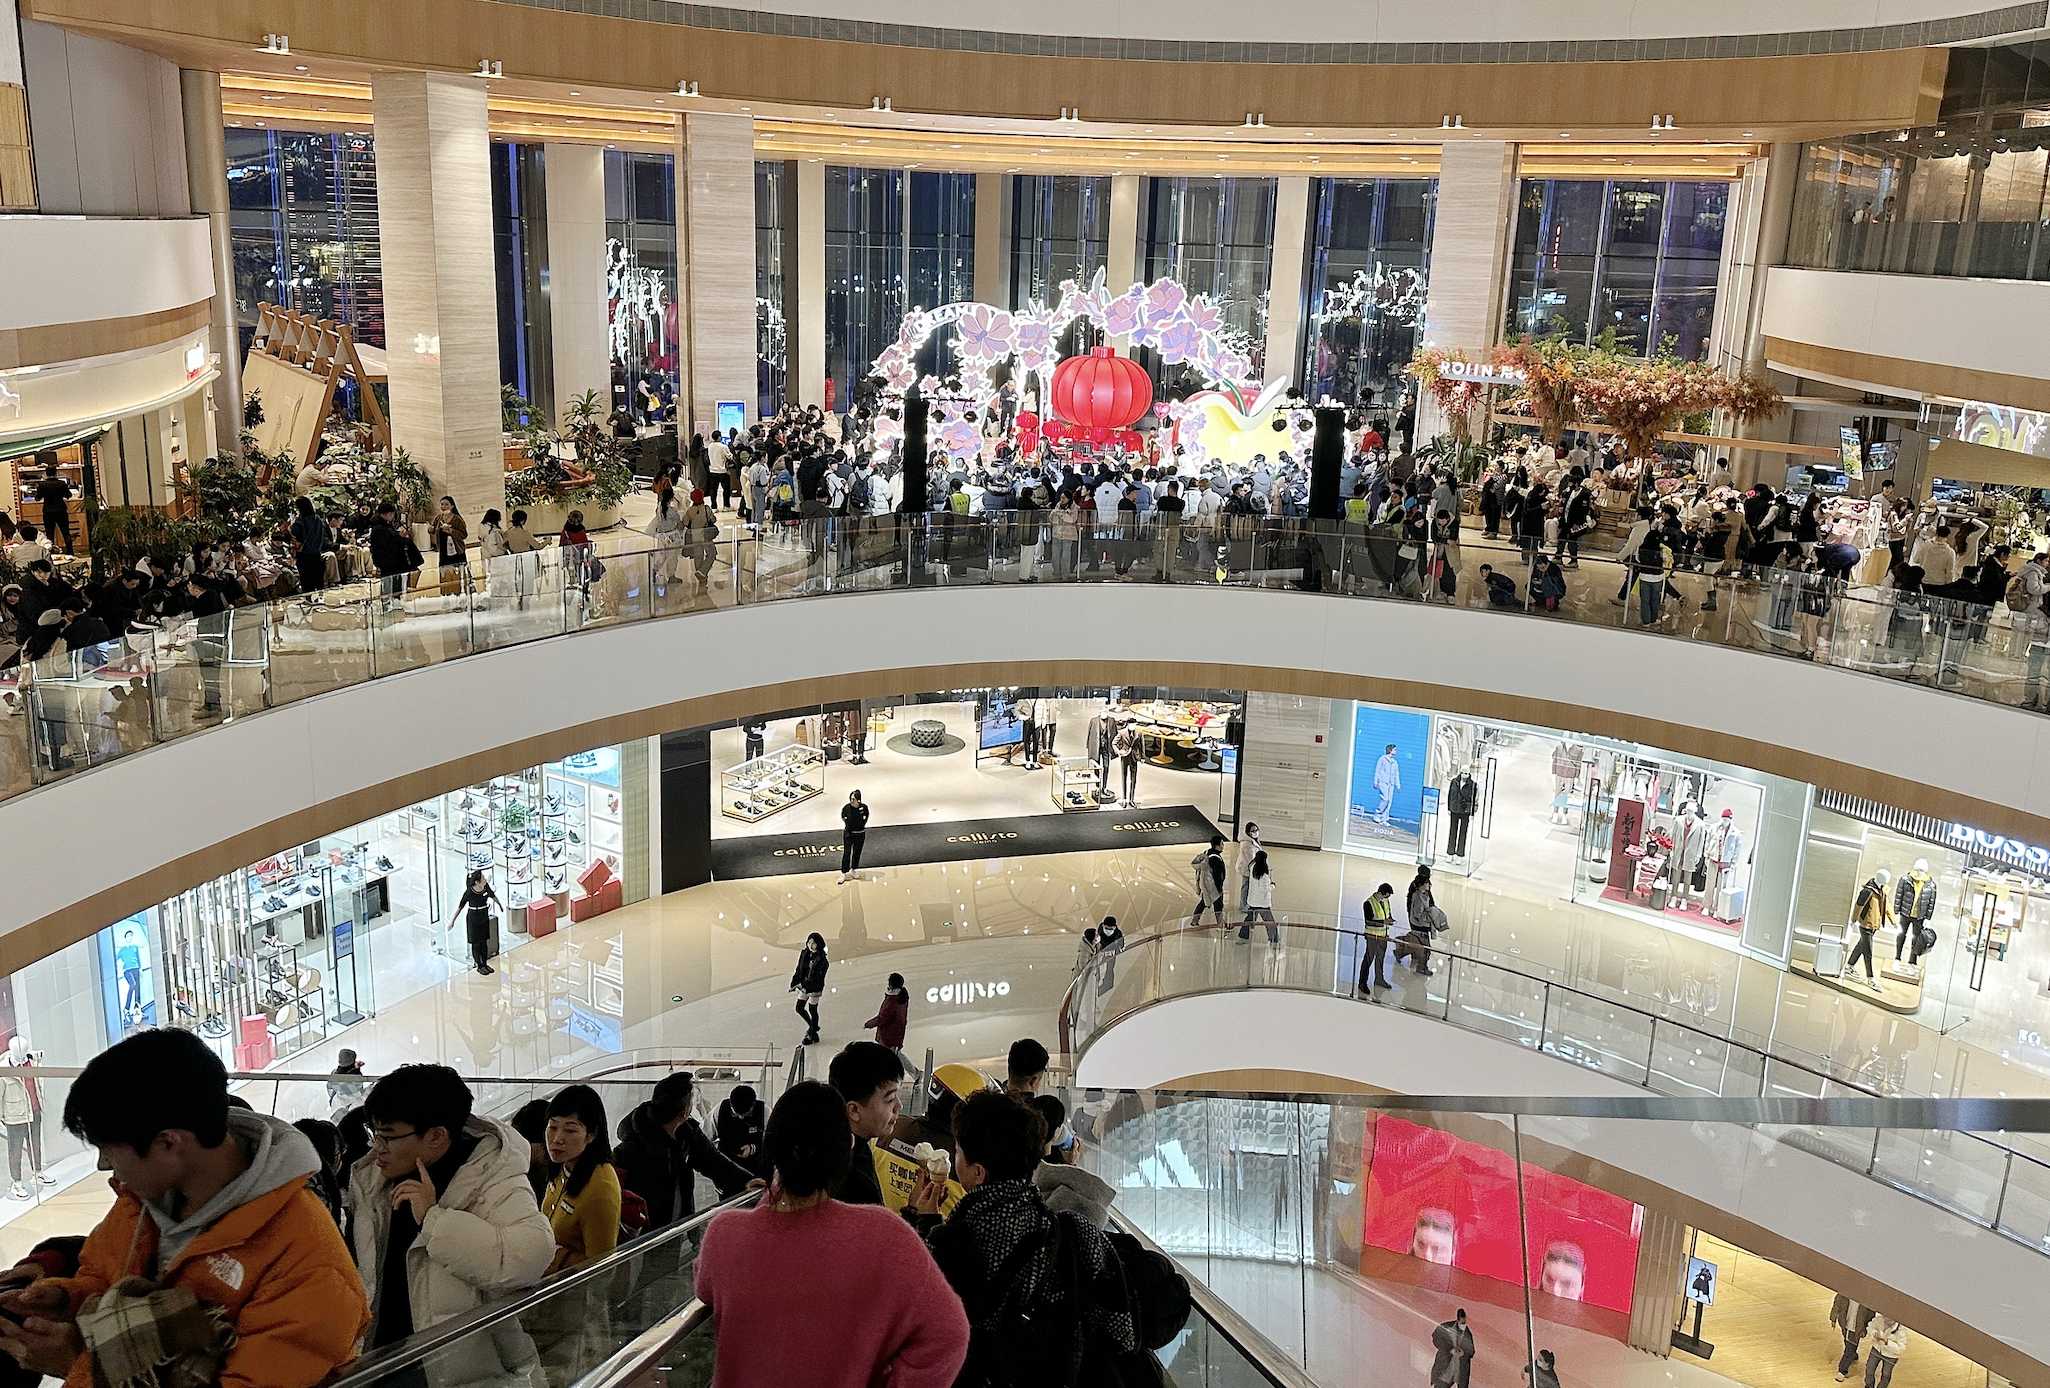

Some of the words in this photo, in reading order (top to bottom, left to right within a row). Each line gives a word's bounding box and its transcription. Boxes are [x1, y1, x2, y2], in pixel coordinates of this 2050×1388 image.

[1112, 821, 1179, 831] callisto
[1373, 828, 1394, 836] ZIOZIA
[946, 832, 1018, 843] callisto
